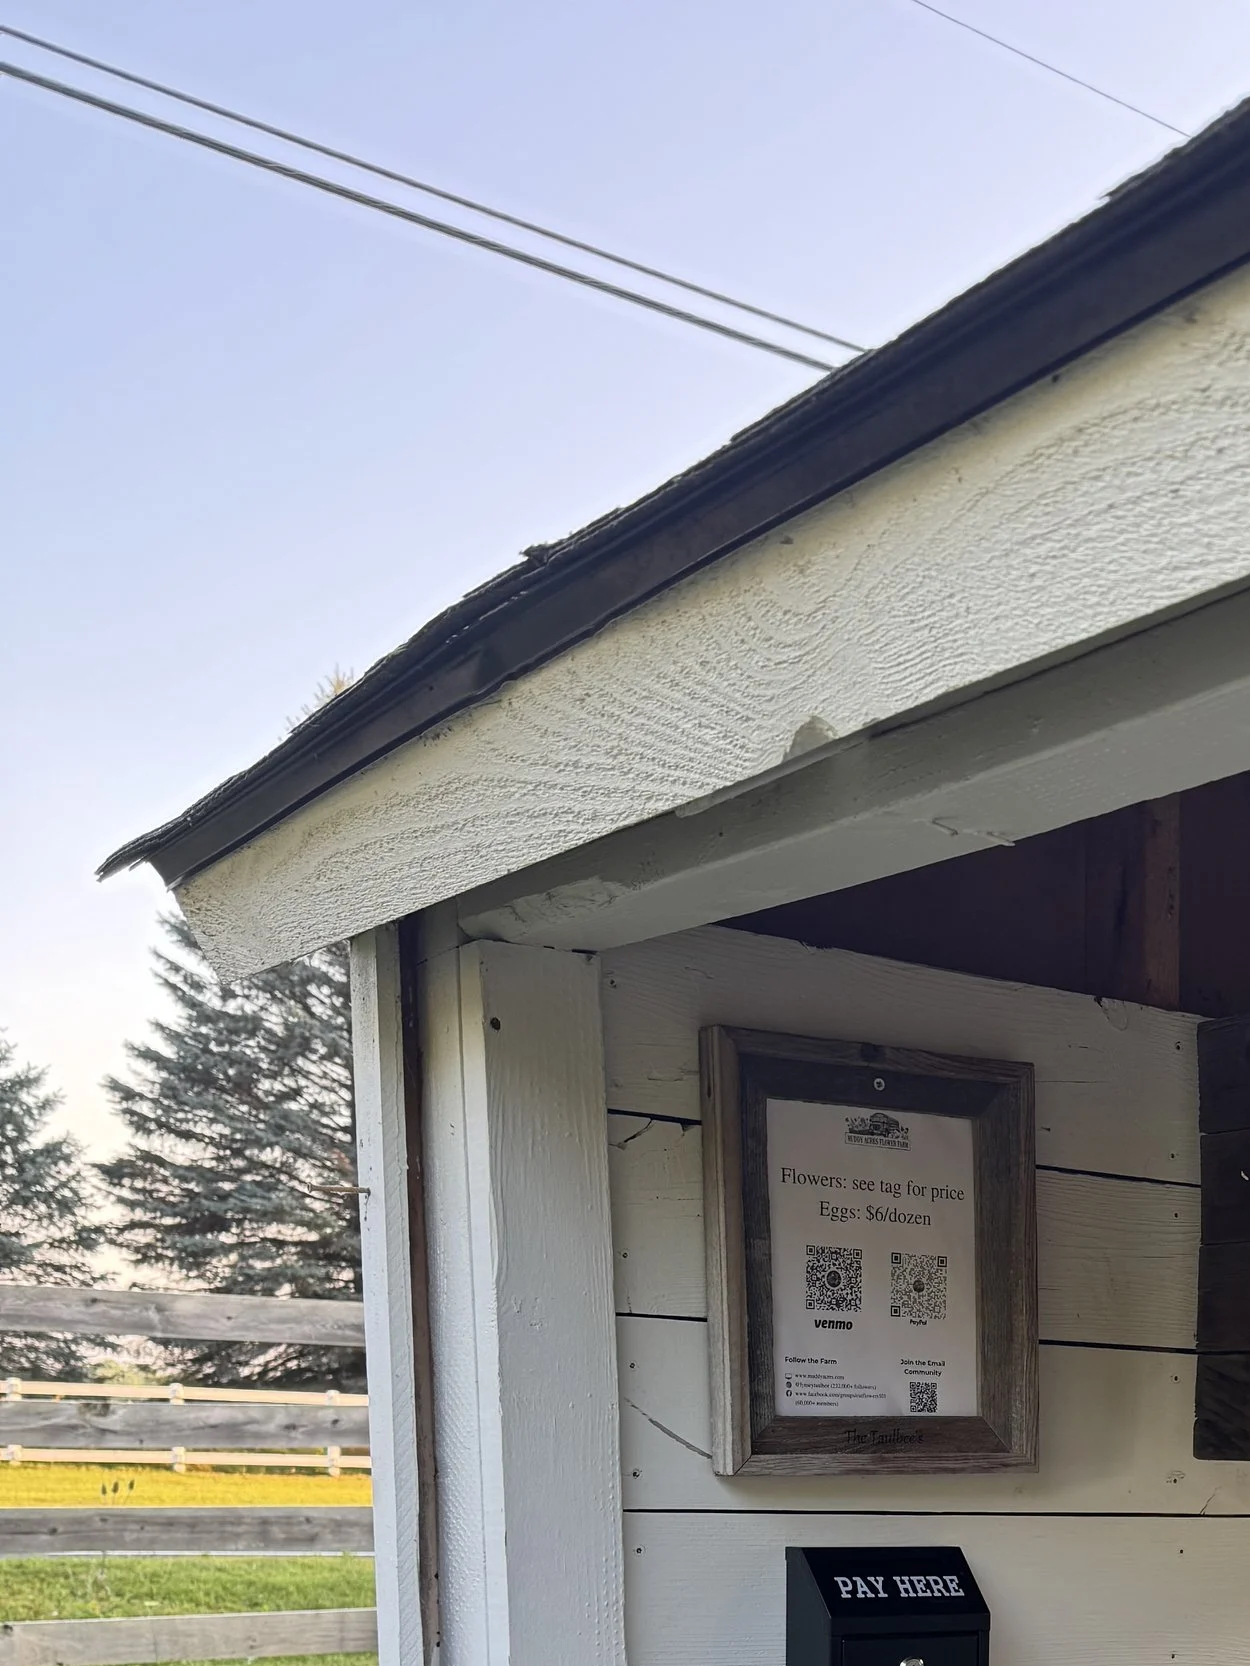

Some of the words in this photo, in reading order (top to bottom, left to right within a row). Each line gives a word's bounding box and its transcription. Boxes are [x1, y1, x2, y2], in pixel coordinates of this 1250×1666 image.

[780, 1167, 847, 1189] Flowers:
[852, 1178, 875, 1192] see
[880, 1180, 902, 1198] tag
[906, 1180, 927, 1197] for
[931, 1184, 965, 1202] price
[819, 1201, 861, 1223] Eggs:
[865, 1204, 932, 1226] $6/dozen
[814, 1319, 853, 1330] venmo
[909, 1319, 928, 1327] PayPal
[784, 1356, 806, 1364] Follow
[807, 1357, 819, 1365] the
[900, 1358, 914, 1366] Join
[915, 1359, 927, 1367] the
[927, 1359, 946, 1367] Email
[904, 1368, 942, 1377] Community
[843, 1428, 867, 1444] The
[834, 1576, 889, 1599] PAY
[892, 1575, 965, 1598] HERE
